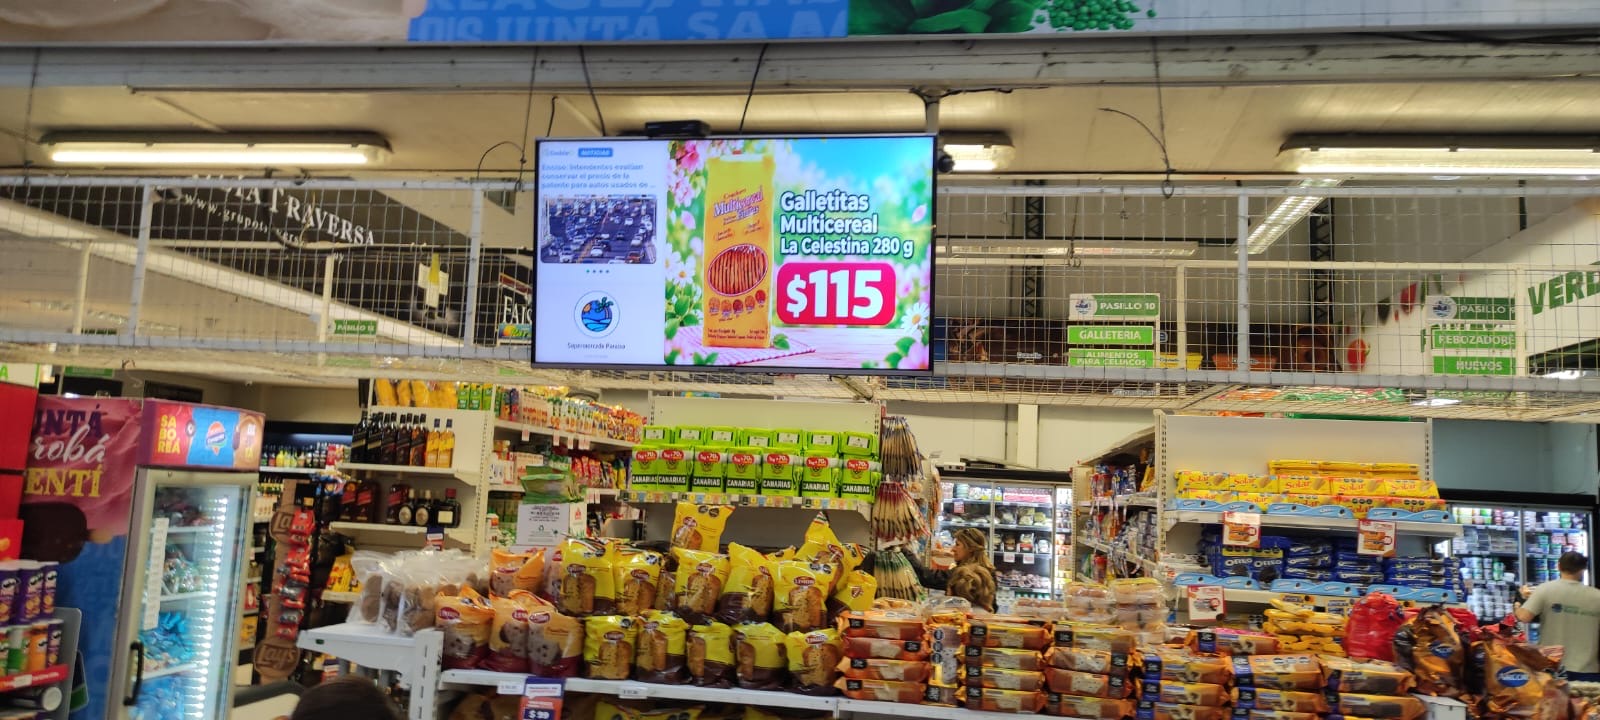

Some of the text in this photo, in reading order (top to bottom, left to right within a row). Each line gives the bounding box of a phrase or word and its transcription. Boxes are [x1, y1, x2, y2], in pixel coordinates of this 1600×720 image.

[780, 189, 869, 212] Galletitas
[780, 213, 878, 234] Multicereal
[781, 236, 914, 258] La Celestina 280 g
[786, 268, 884, 319] $115
[1099, 302, 1156, 310] PASILLO 10
[1460, 305, 1506, 314] PASILLO
[1079, 329, 1142, 340] GALLETERIA
[1086, 351, 1139, 359] ALIMENTOS
[1455, 360, 1504, 371] HUEVOS
[160, 414, 177, 428] SA
[159, 428, 177, 440] BO
[659, 475, 686, 484] CANARIAS
[693, 477, 721, 486] CANARIAS
[1286, 479, 1312, 489] Solar
[727, 480, 755, 489] CANARIAS
[763, 480, 791, 489] CANARIAS
[803, 482, 830, 491] CANARIAS
[843, 484, 870, 493] CANARIAS
[1339, 483, 1366, 492] Solar
[1225, 557, 1253, 566] OREO
[1253, 558, 1282, 568] OREO
